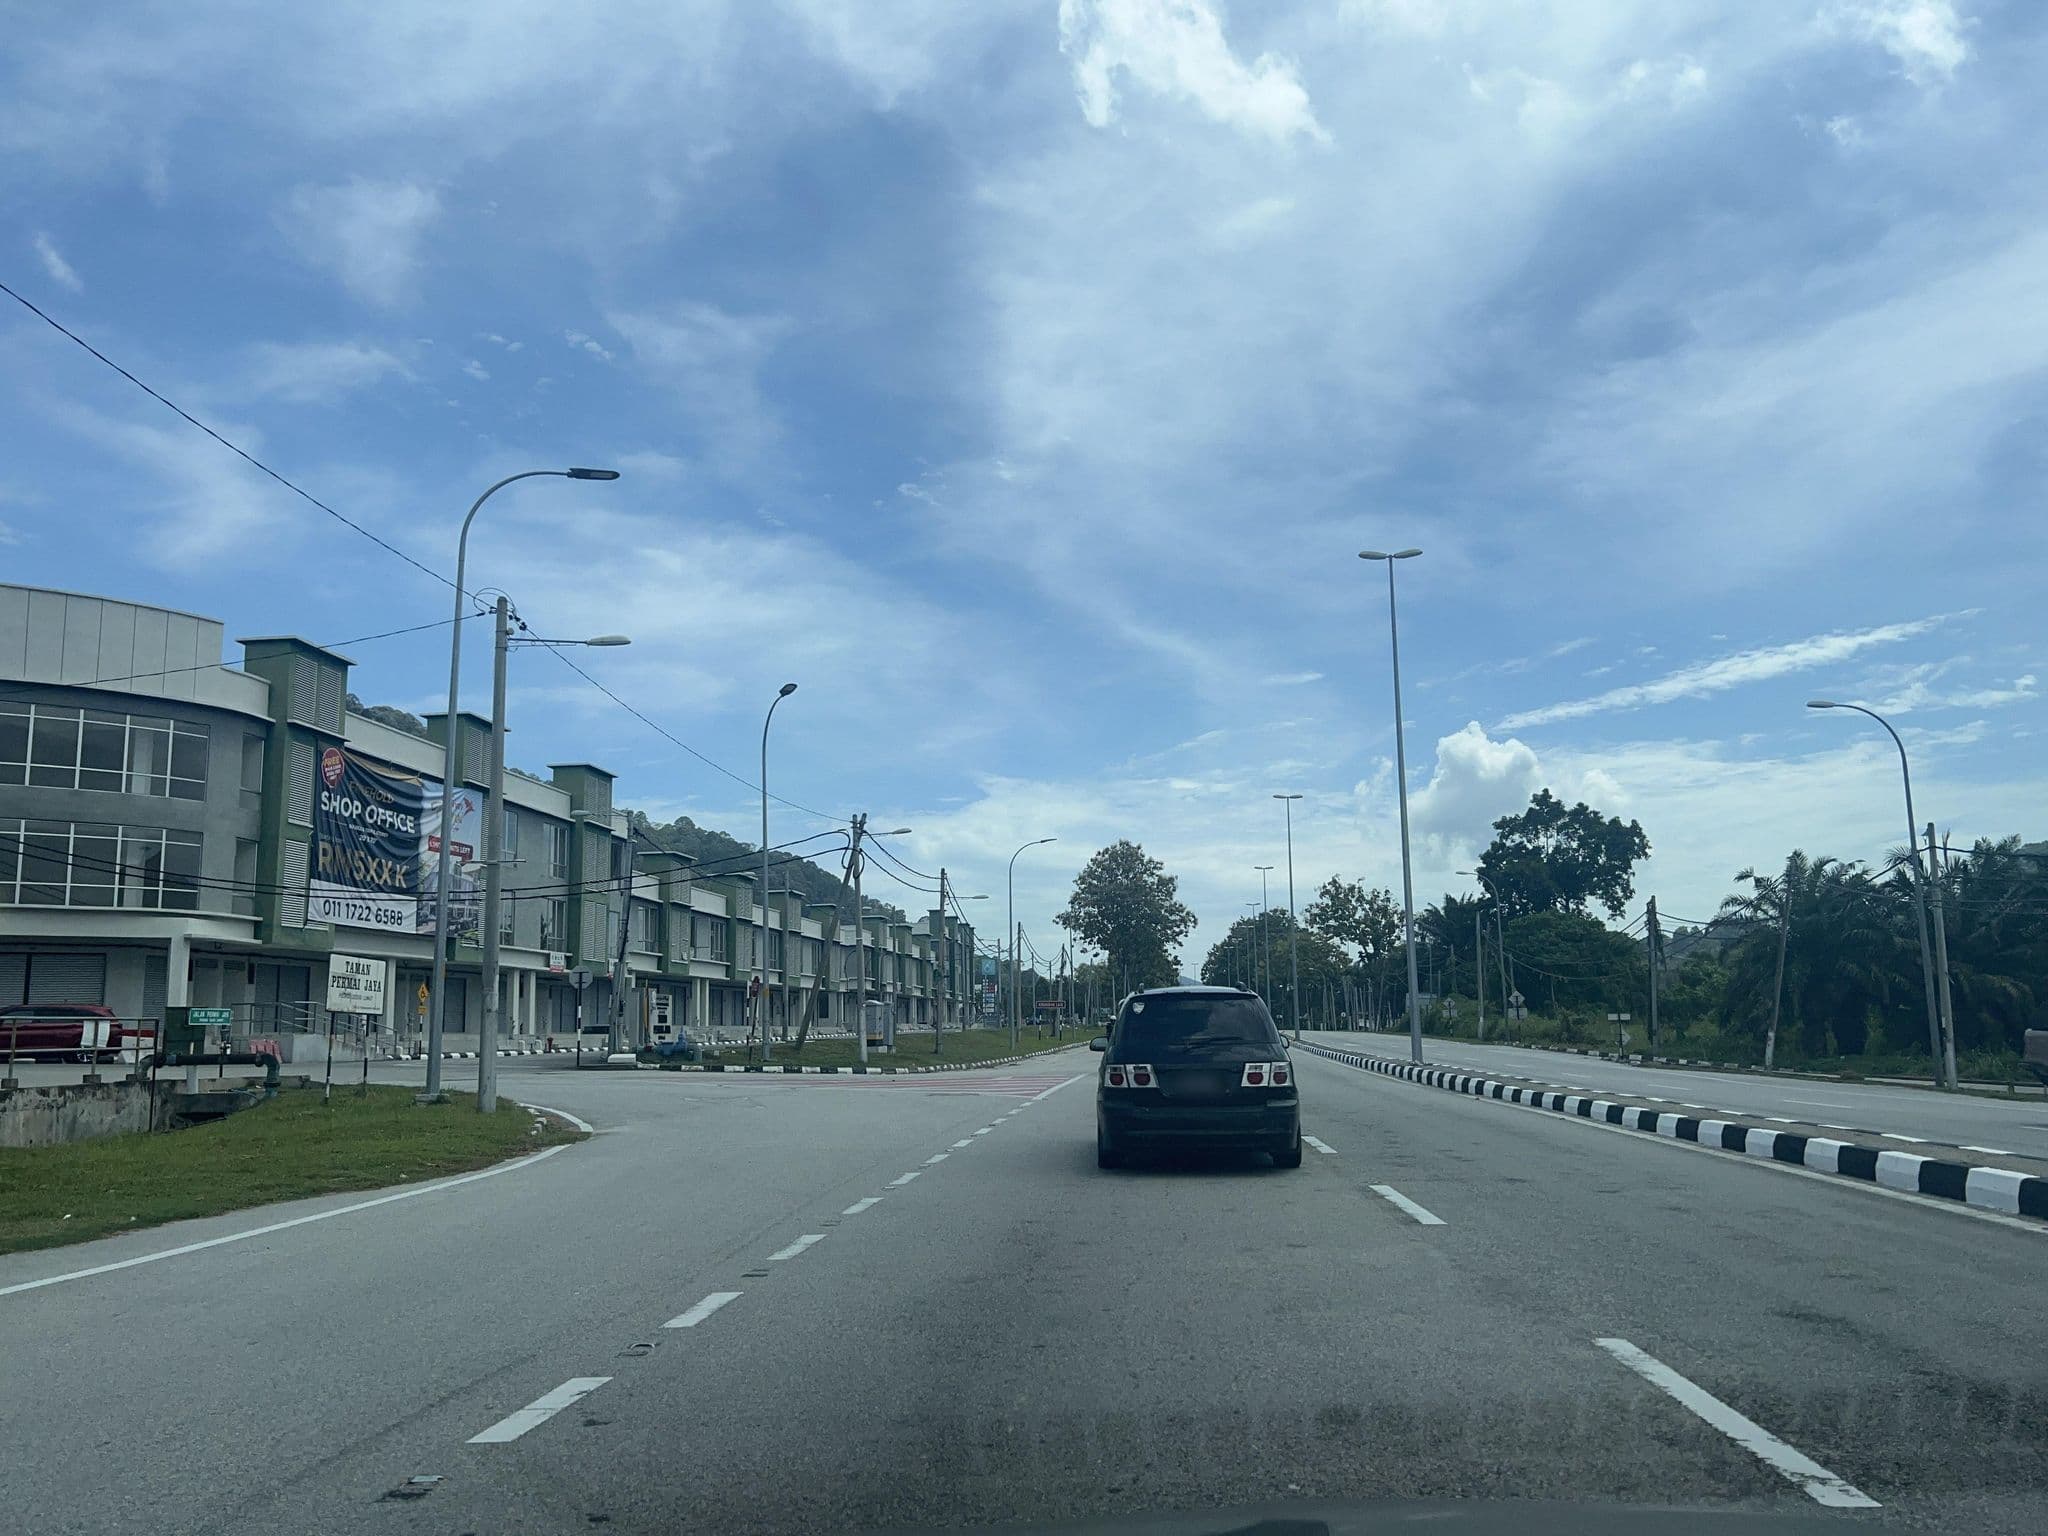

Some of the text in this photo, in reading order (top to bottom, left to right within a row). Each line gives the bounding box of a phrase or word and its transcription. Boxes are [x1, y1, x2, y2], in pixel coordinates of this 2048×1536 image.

[321, 791, 361, 819] SHOP
[365, 805, 415, 834] OFFICE
[323, 899, 403, 926] 011 1722 6588
[345, 961, 371, 975] TAMAN
[331, 975, 381, 992] PERMAI JAYA
